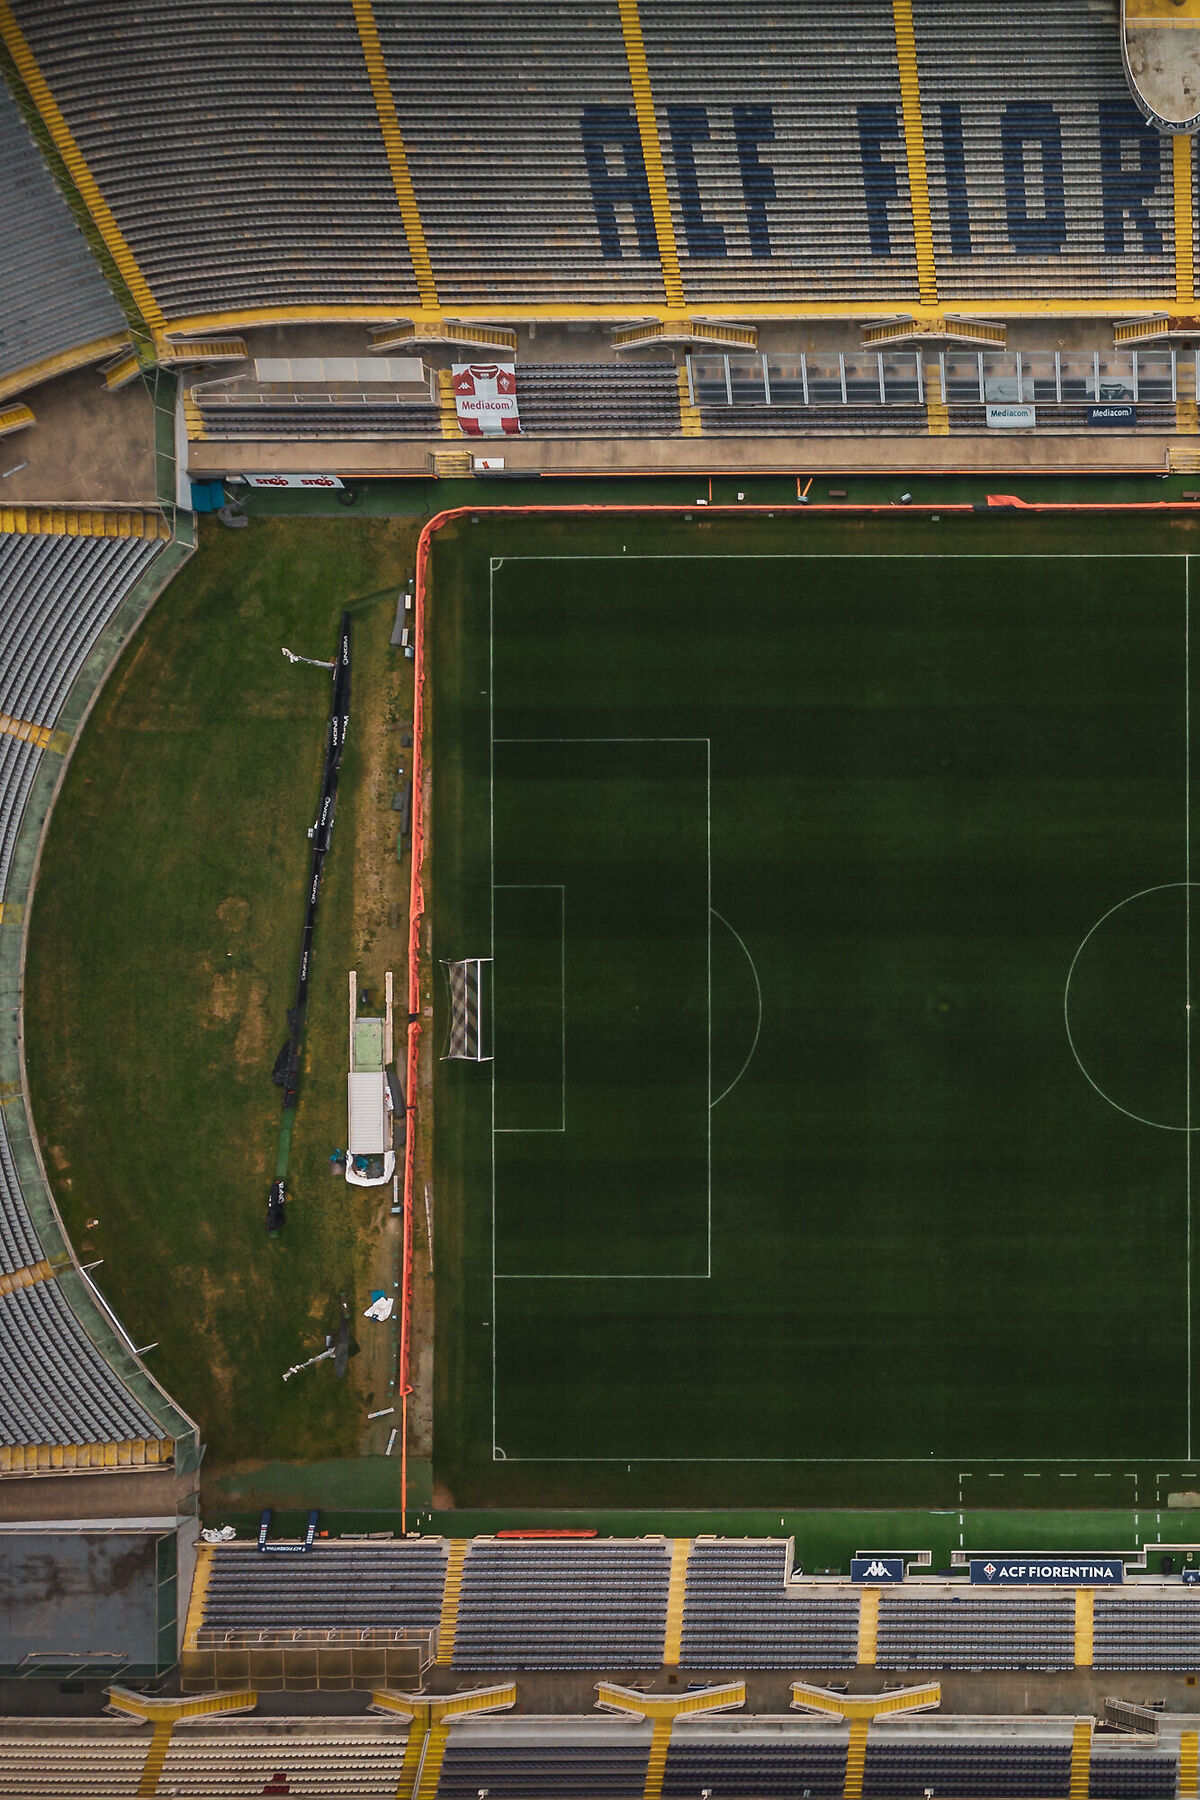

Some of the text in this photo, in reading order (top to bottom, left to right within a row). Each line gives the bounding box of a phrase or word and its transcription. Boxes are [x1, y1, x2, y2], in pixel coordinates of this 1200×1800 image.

[580, 106, 775, 259] ACF
[462, 400, 510, 410] Mediacom
[991, 408, 1029, 418] Mediacom
[1093, 407, 1129, 418] Mediacom
[999, 1566, 1114, 1578] ACF FIORENTINA
